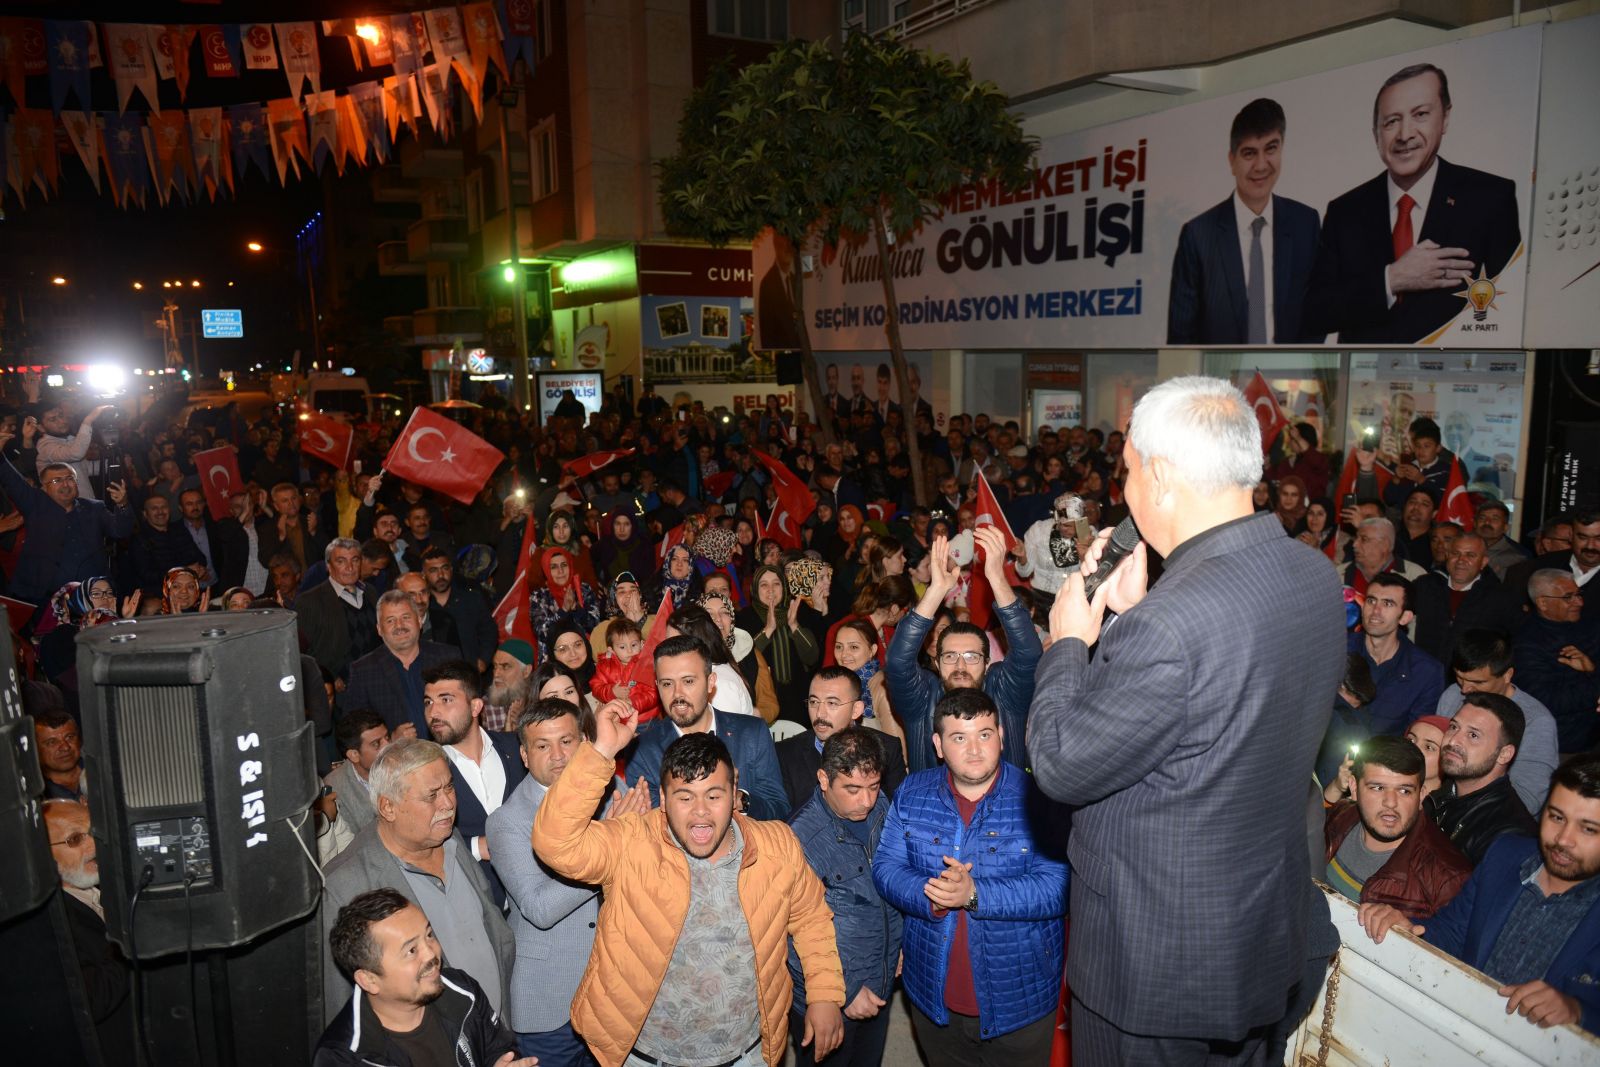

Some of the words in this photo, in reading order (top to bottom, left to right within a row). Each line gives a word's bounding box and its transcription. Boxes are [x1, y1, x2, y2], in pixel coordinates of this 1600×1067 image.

[1103, 138, 1147, 192] İŞİ
[936, 204, 1078, 274] GÖNÜL
[1083, 190, 1146, 268] İŞİ
[840, 244, 925, 284] Kumuca
[815, 302, 859, 331] SEÇİM
[863, 294, 1018, 329] KORDİNASYON
[1024, 279, 1142, 319] MERKEZİ
[545, 379, 584, 388] BELEDİYE
